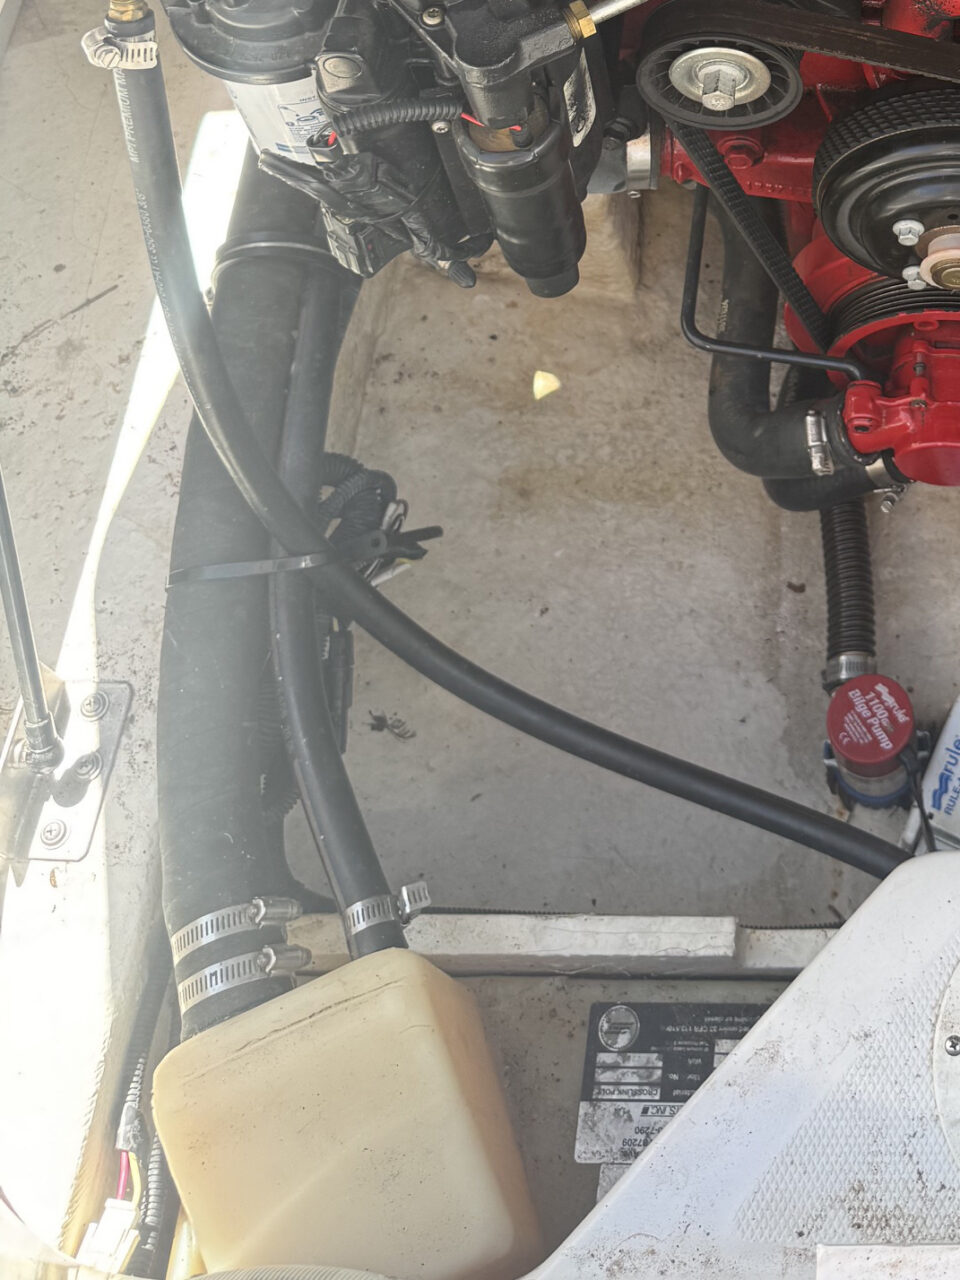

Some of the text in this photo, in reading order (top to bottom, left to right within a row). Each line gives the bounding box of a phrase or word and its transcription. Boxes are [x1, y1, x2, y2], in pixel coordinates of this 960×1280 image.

[848, 688, 872, 718] Bilge
[866, 716, 894, 749] Pump
[615, 1087, 659, 1098] CROSSLINK
